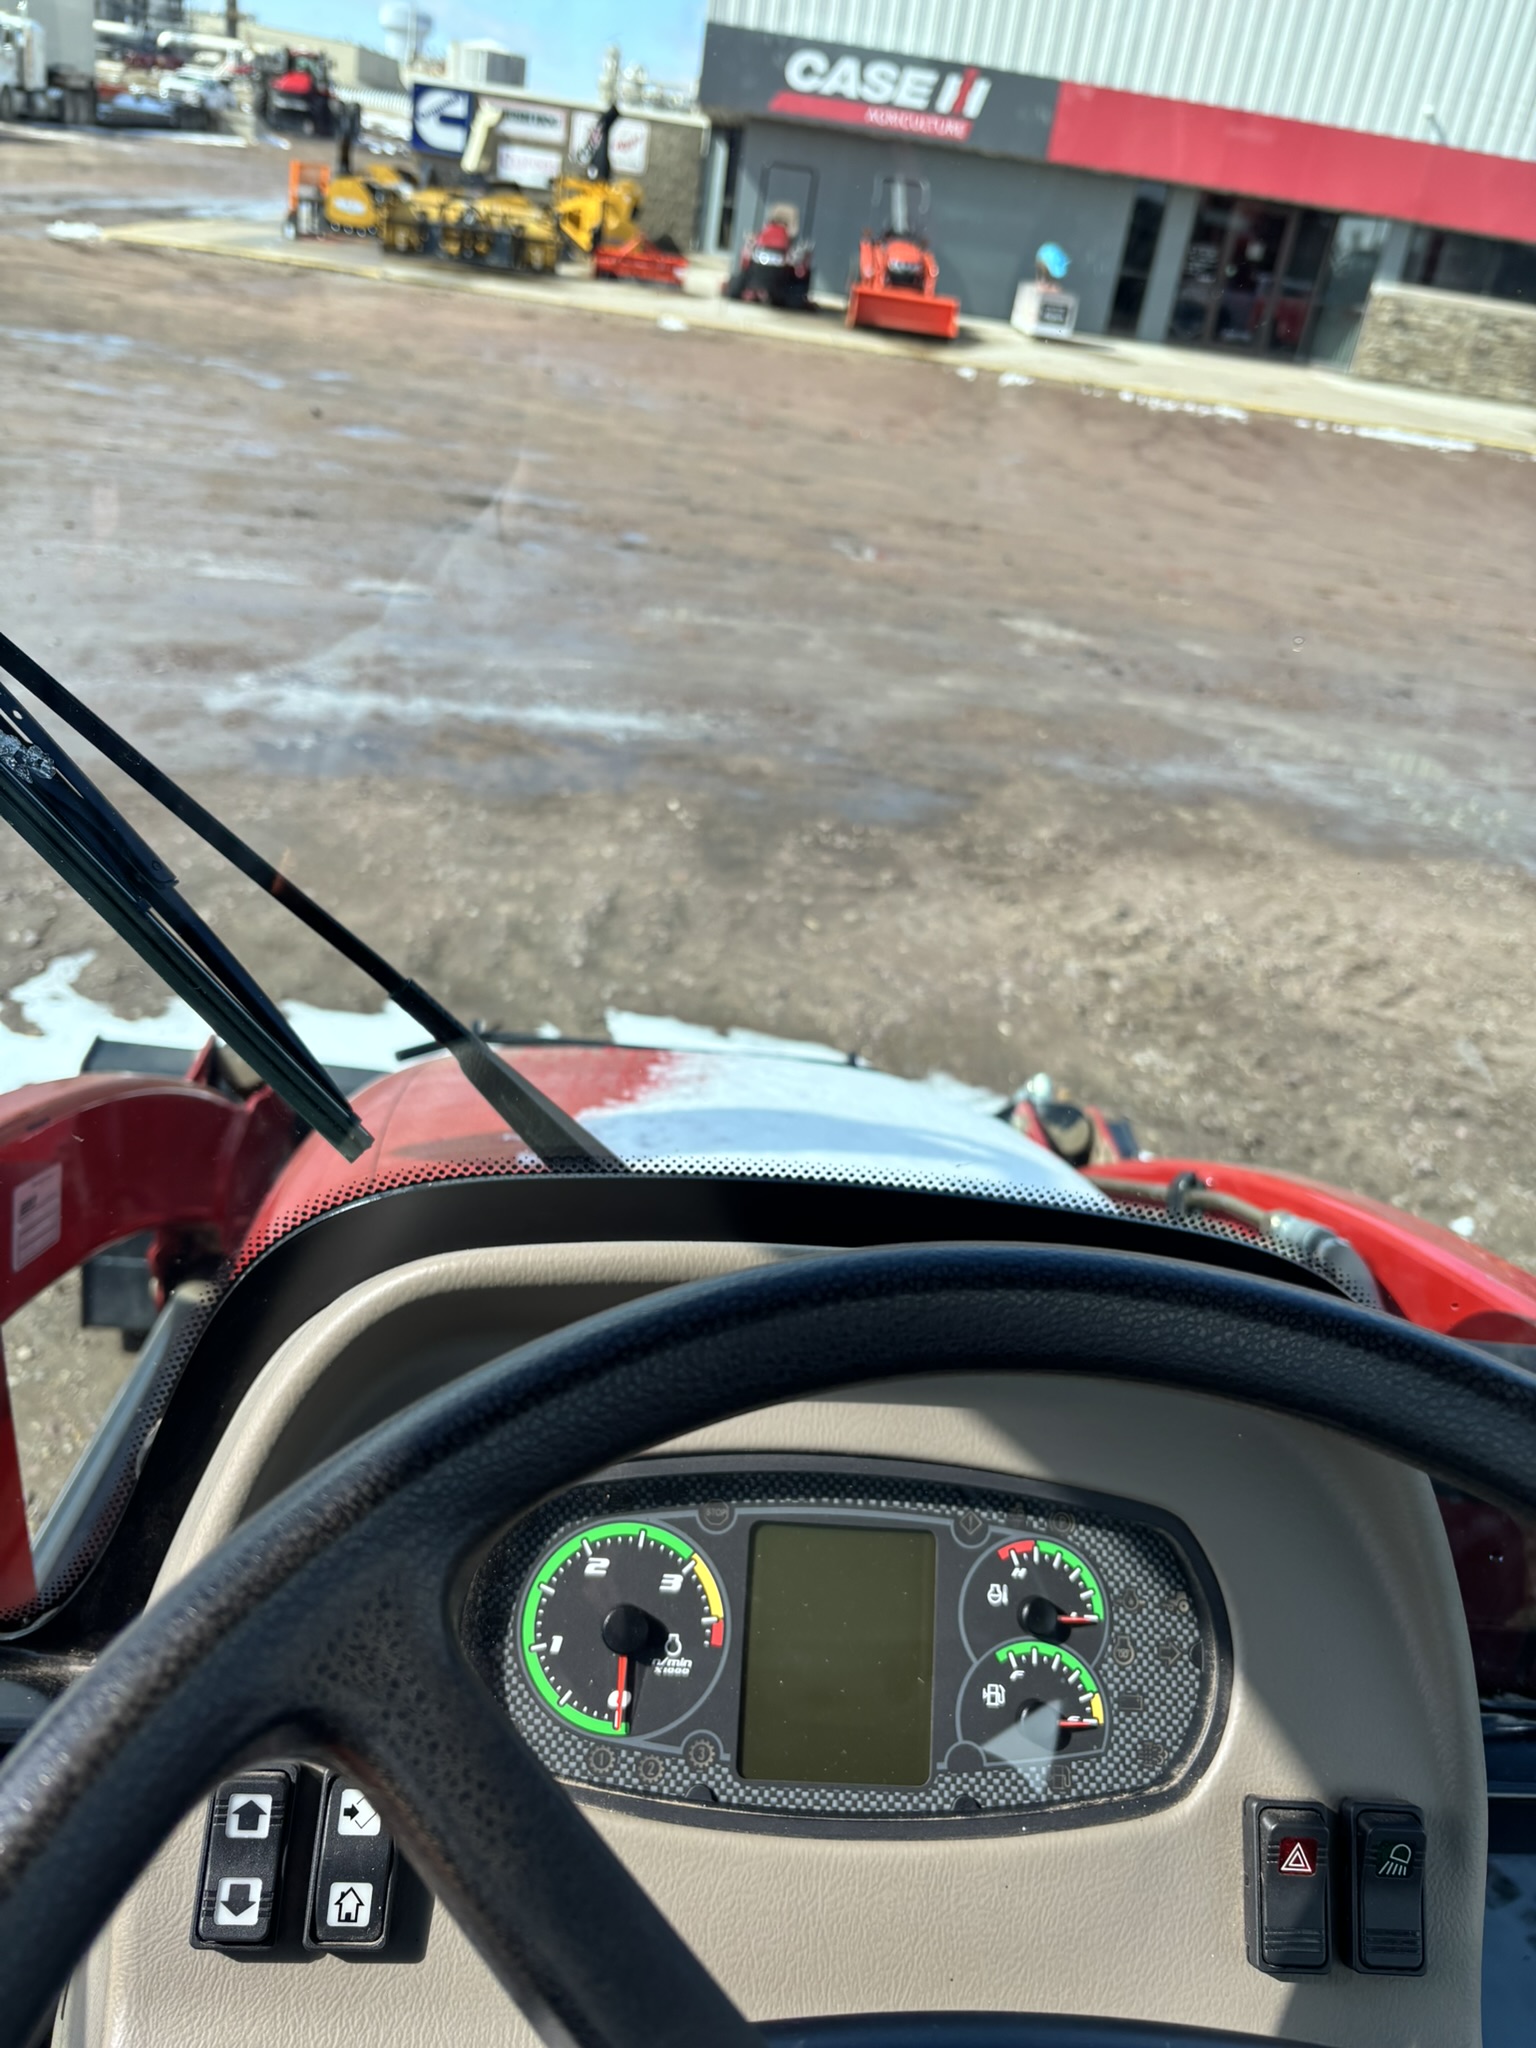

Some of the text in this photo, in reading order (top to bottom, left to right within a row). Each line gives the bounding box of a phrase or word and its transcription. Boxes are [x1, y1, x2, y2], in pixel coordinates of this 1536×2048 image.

[785, 48, 939, 110] CASE
[703, 1507, 728, 1517] STOP
[584, 1557, 610, 1577] 2
[659, 1574, 683, 1594] 3
[550, 1635, 563, 1654] 1
